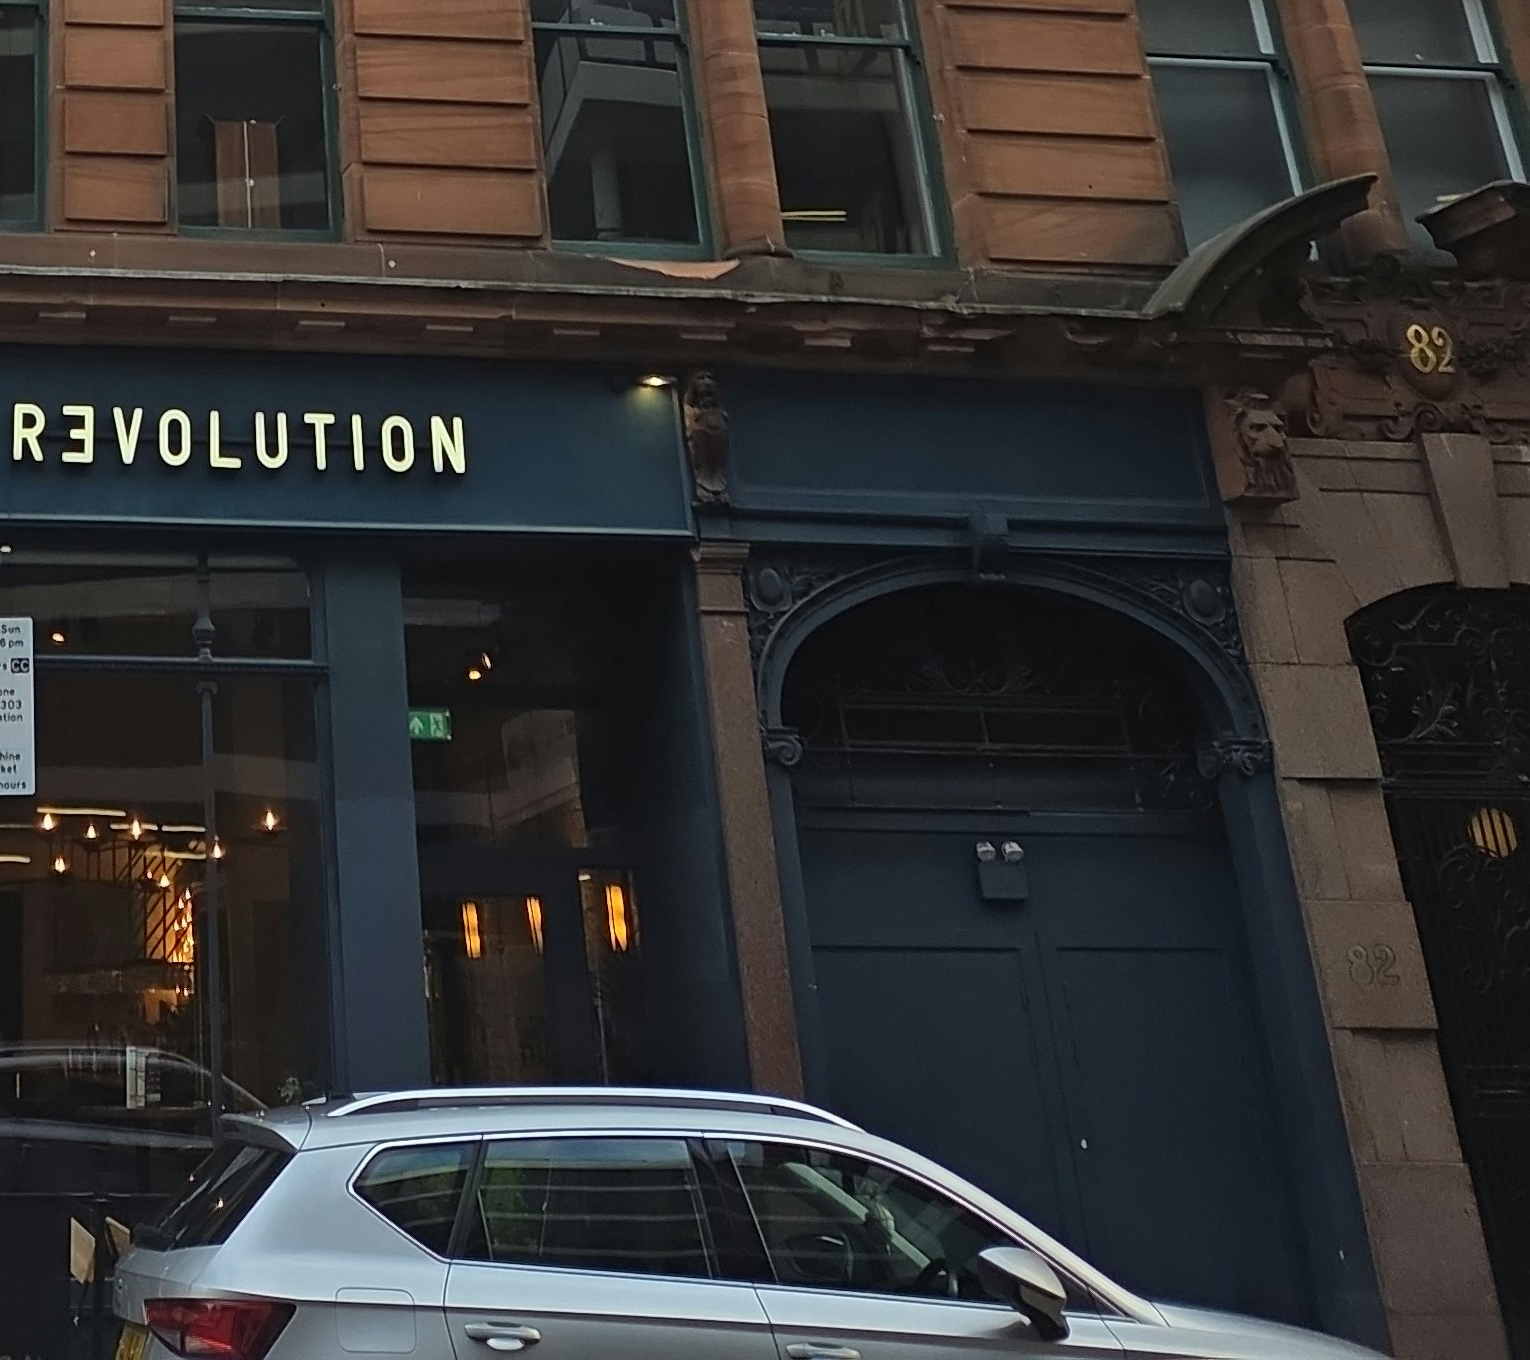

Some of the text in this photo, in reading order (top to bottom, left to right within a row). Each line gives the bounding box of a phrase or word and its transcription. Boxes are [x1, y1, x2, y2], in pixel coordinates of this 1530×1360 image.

[1406, 324, 1456, 374] 82
[11, 401, 469, 476] REVOLUTION
[1, 624, 21, 634] Sun
[11, 659, 30, 673] CC
[1348, 943, 1401, 988] 82
